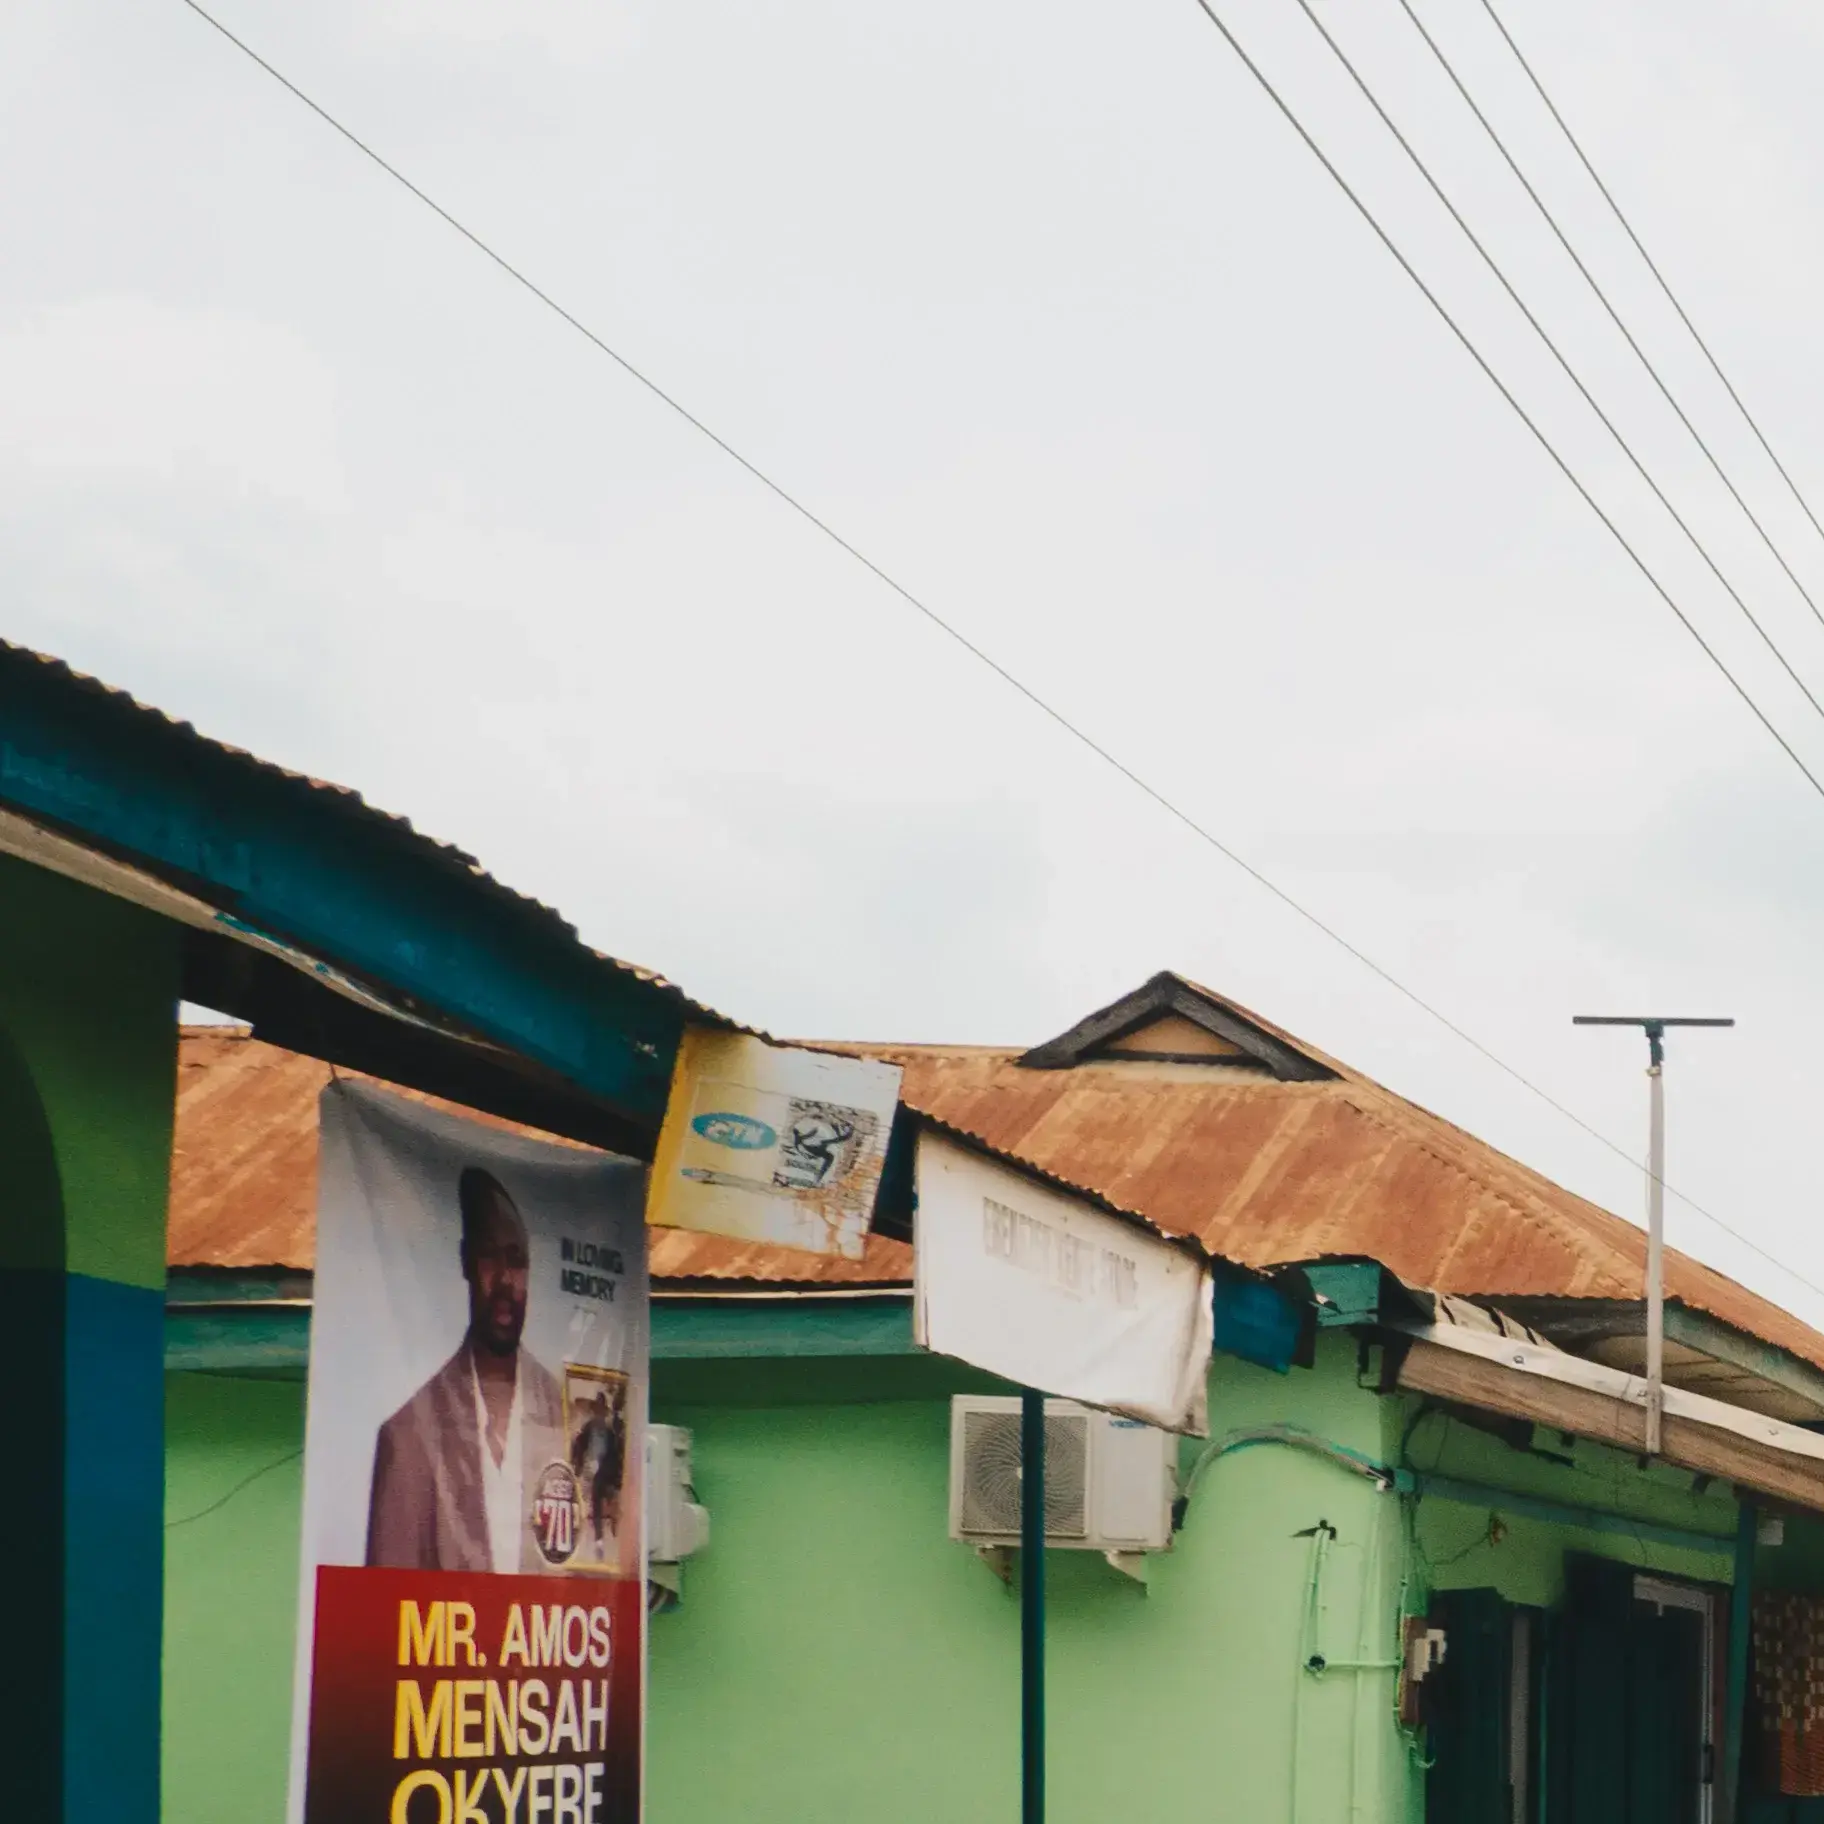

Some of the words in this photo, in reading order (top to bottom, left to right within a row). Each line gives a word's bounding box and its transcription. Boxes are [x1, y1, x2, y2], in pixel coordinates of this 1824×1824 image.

[561, 1269, 616, 1302] MEMORY
[397, 1600, 488, 1667] MR.
[499, 1603, 611, 1668] AMOS
[393, 1679, 609, 1759] MENSAH
